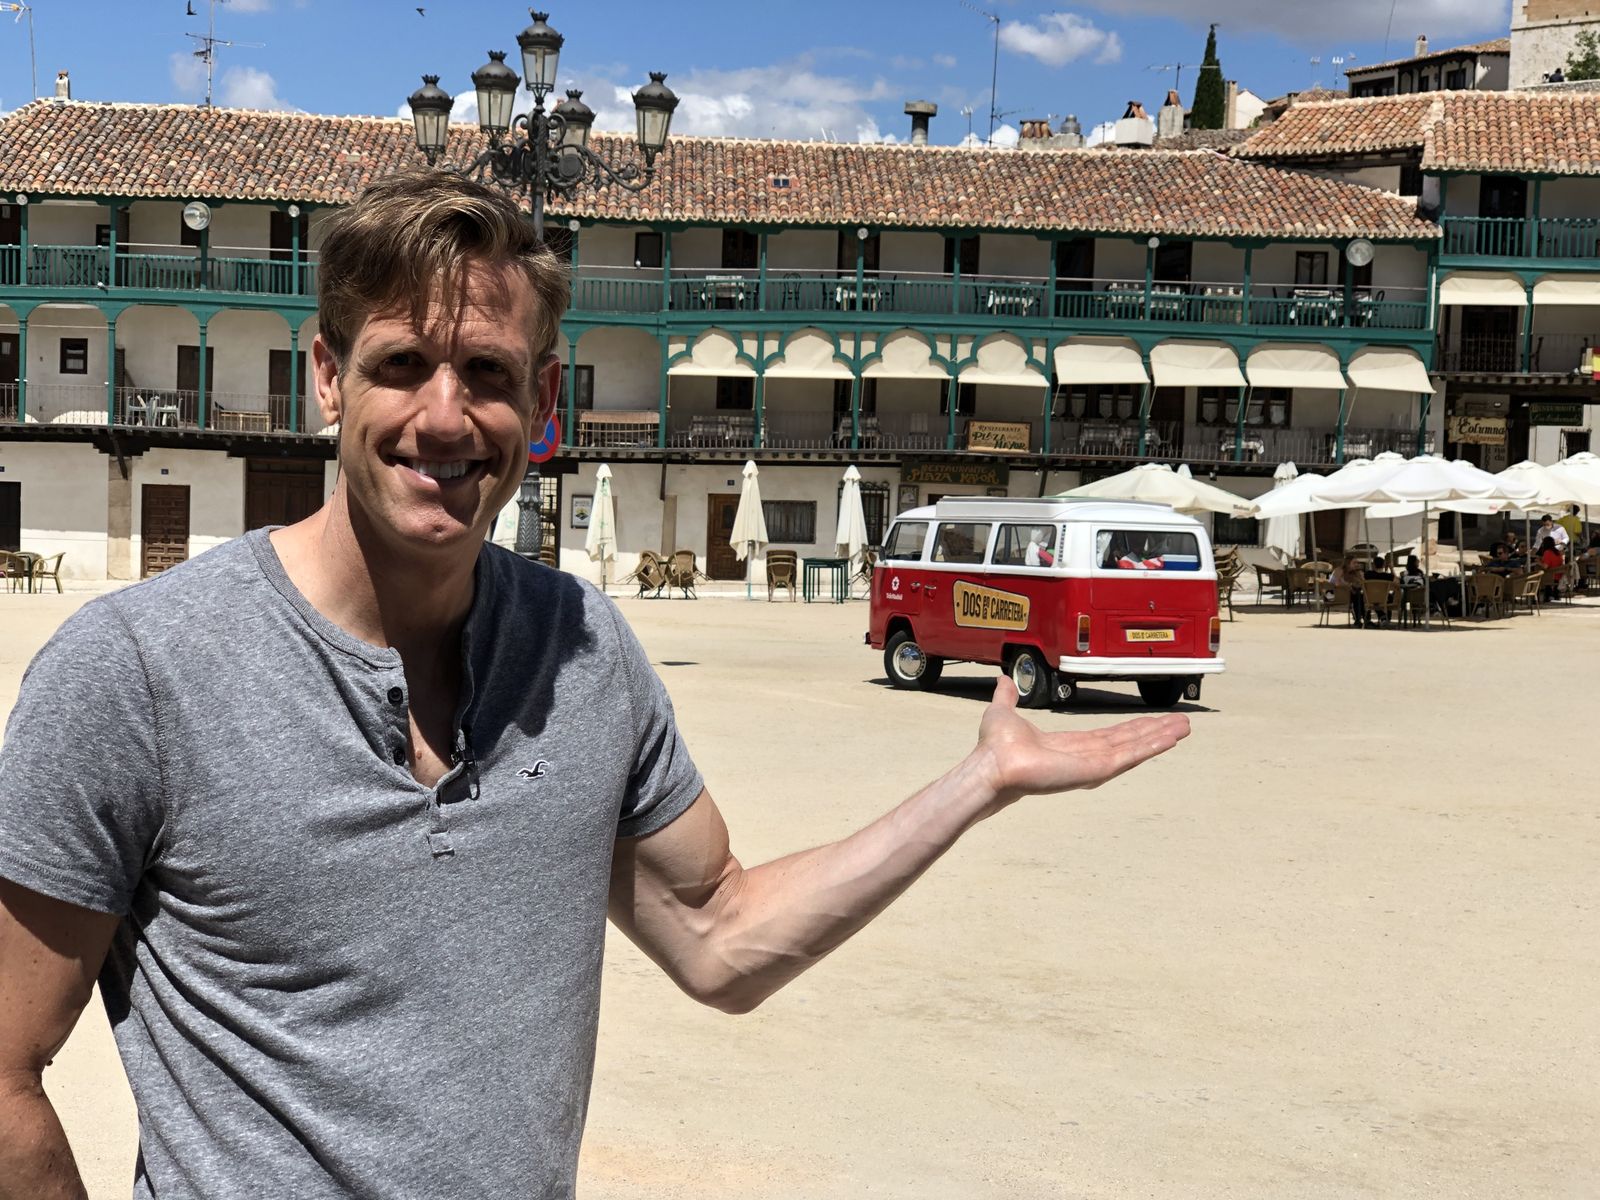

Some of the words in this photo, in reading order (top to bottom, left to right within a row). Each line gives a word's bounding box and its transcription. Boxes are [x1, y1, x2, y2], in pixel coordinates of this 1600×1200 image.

[1459, 423, 1505, 434] Columna
[920, 463, 989, 473] RESTAURANTE
[907, 468, 952, 482] PLAZA
[959, 468, 999, 484] MAYOR
[963, 591, 981, 617] DOS
[990, 597, 1024, 622] CARRETERA
